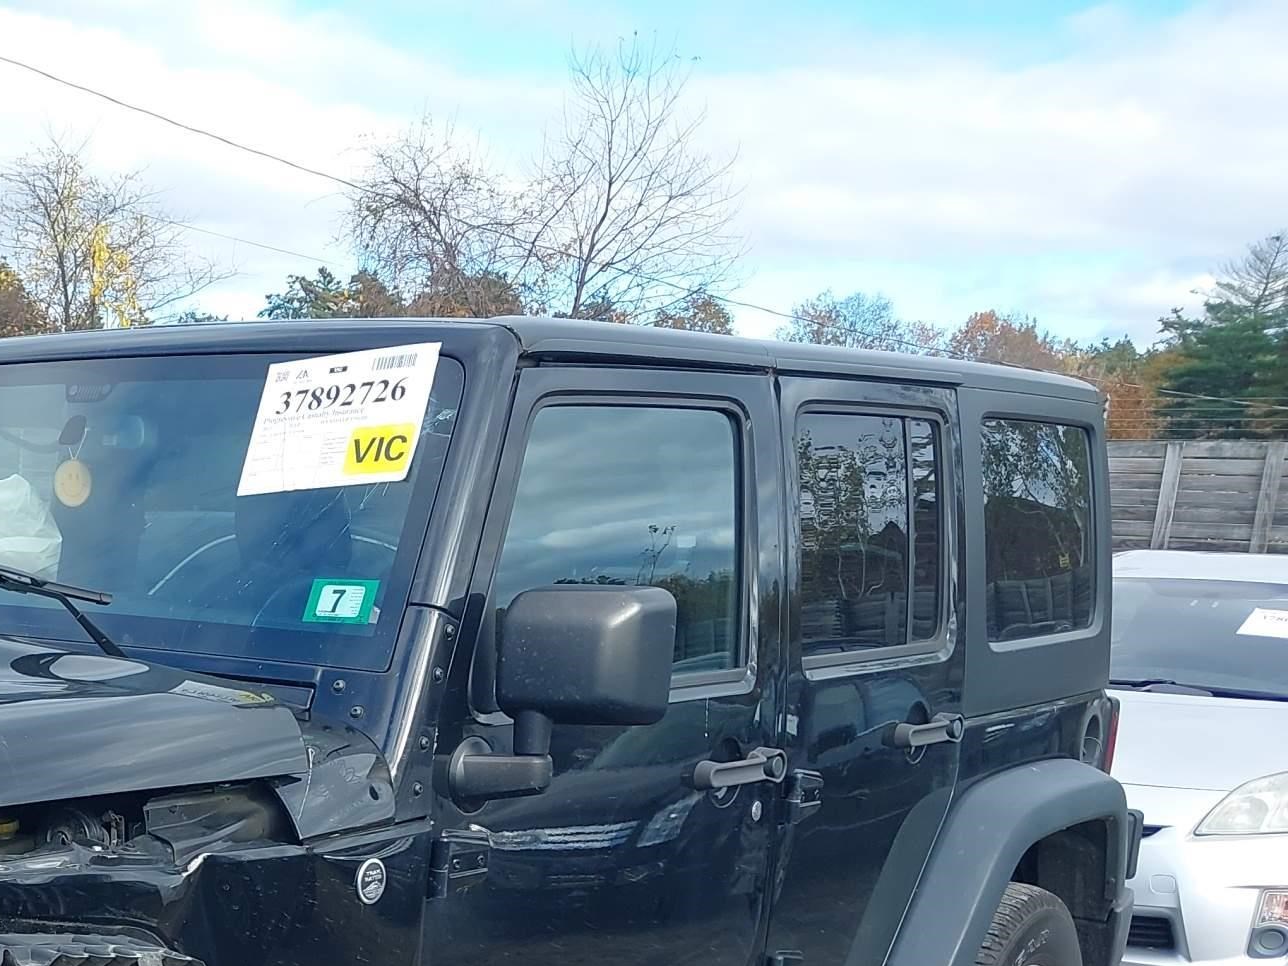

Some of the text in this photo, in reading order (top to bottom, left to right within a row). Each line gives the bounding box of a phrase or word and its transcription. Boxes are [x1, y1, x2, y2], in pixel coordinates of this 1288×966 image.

[275, 376, 409, 414] 37892726
[353, 434, 408, 463] VIC
[332, 588, 347, 613] 7
